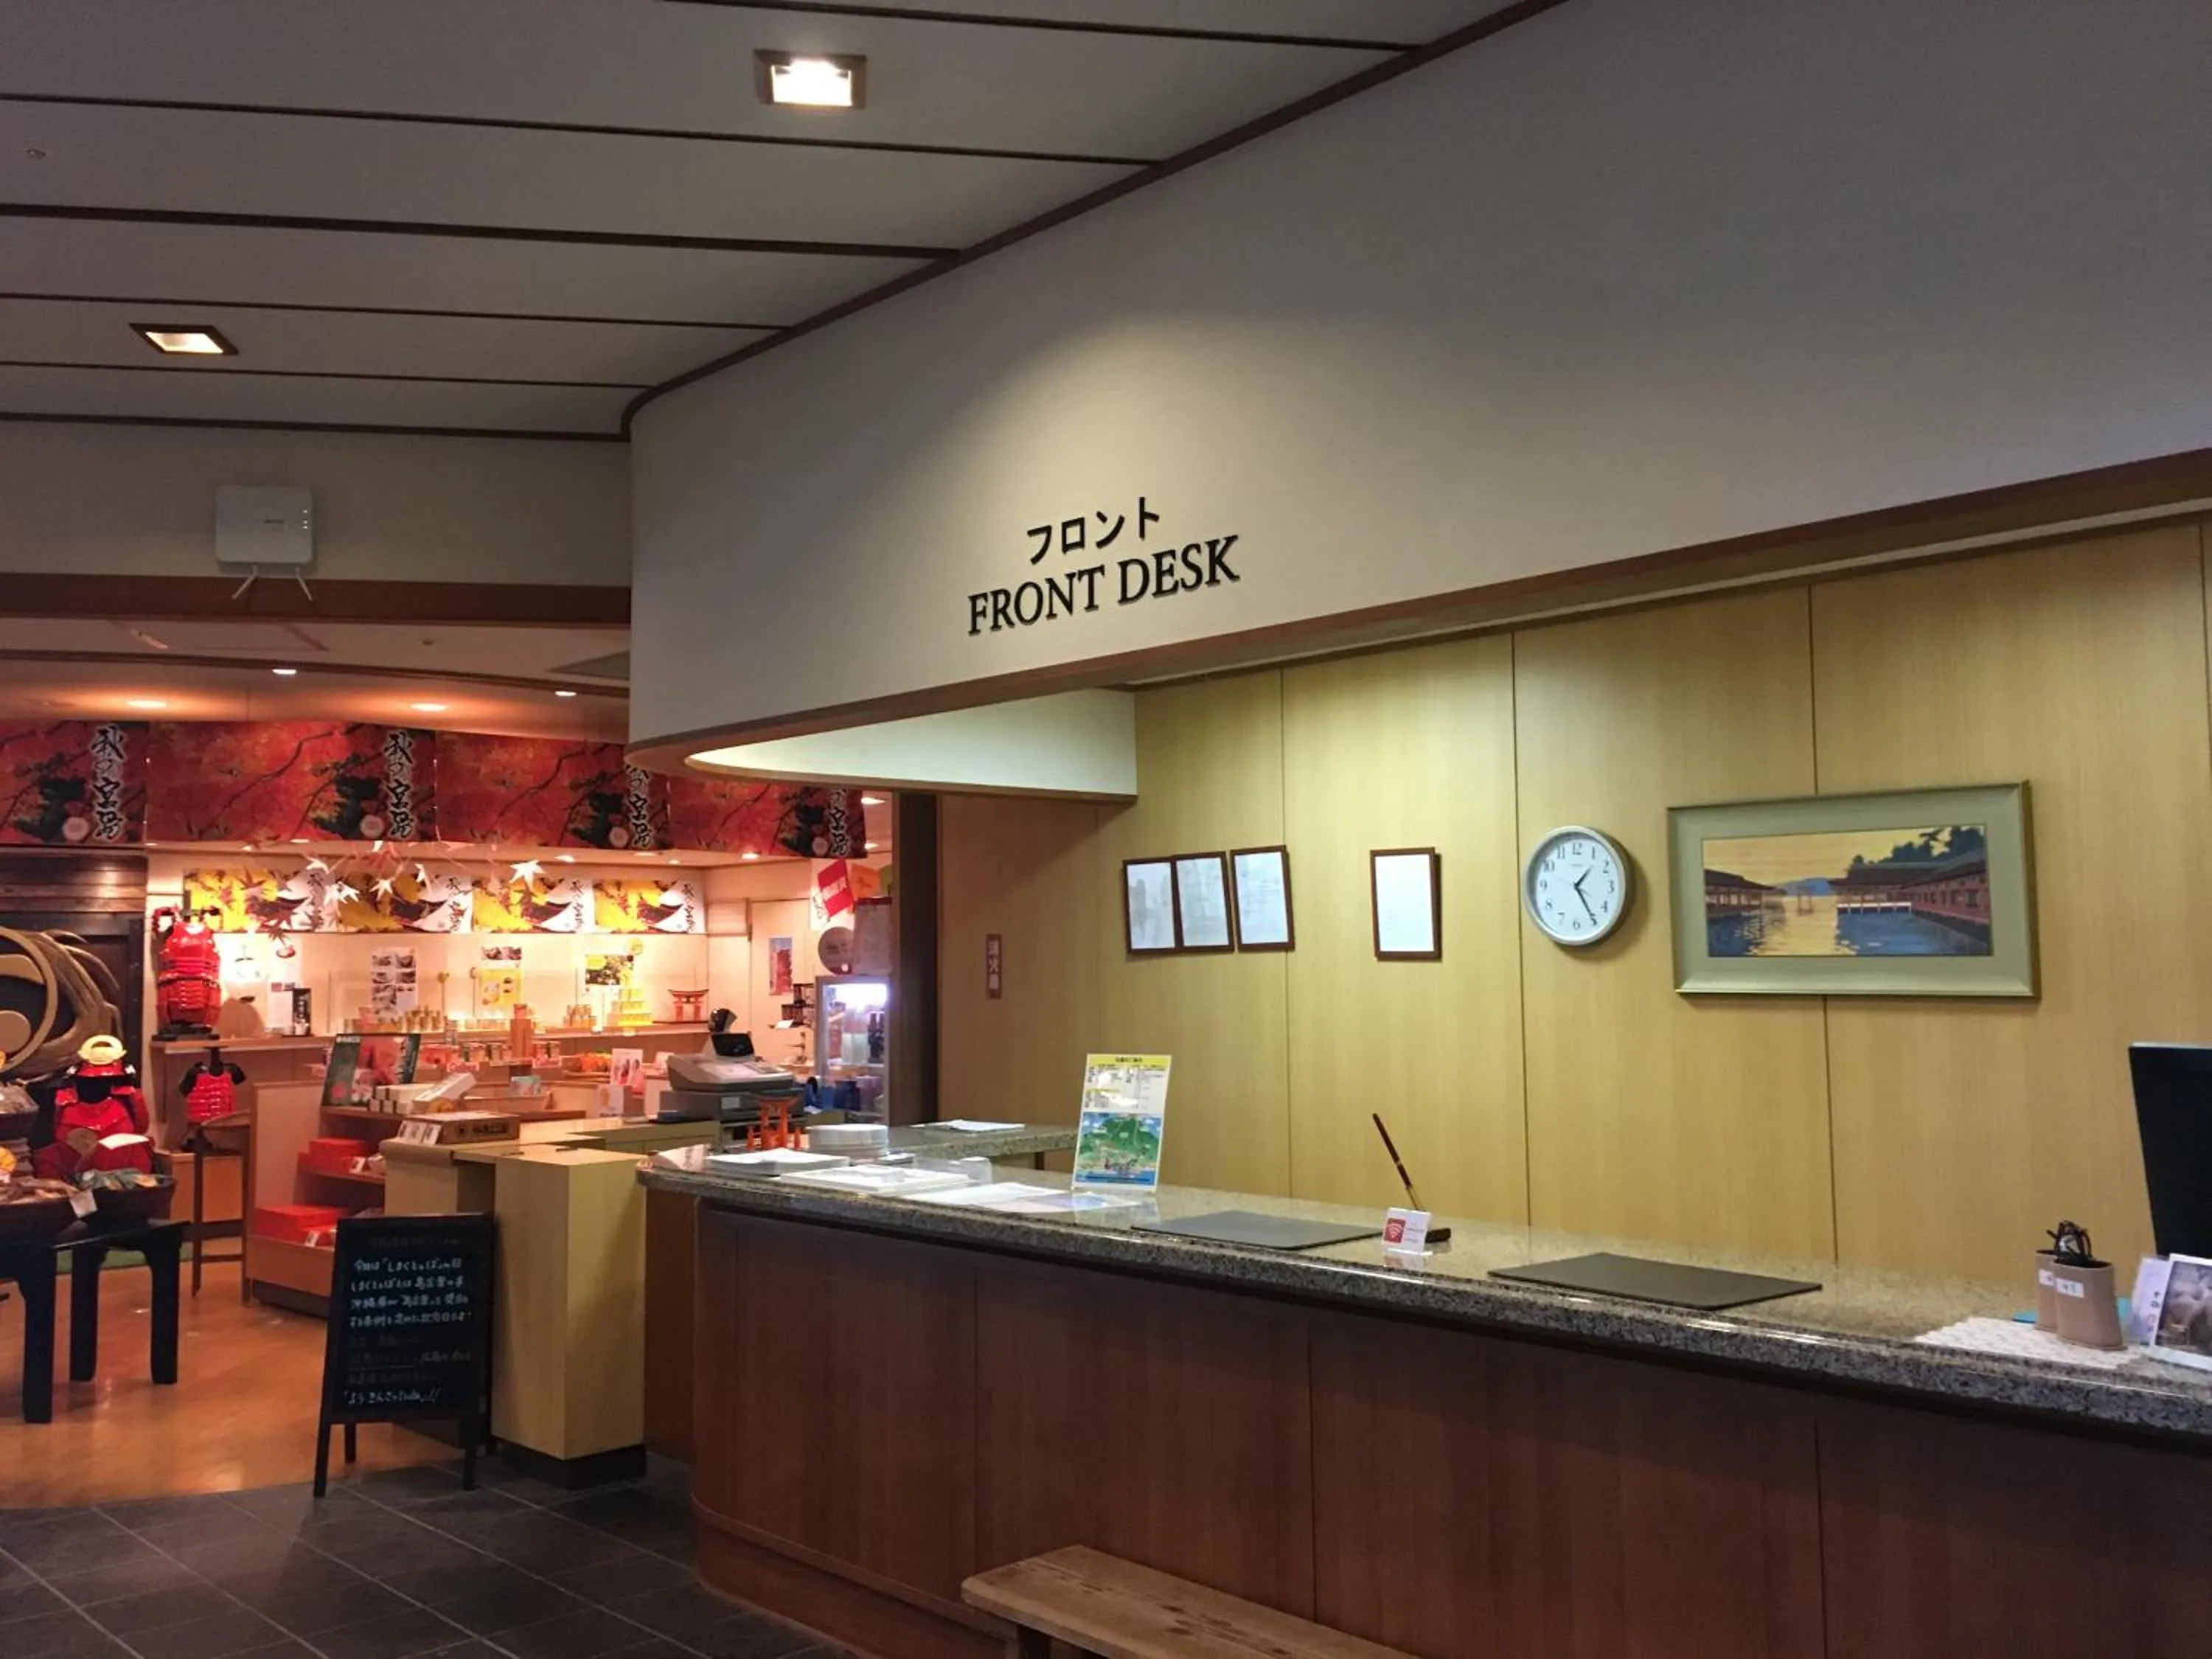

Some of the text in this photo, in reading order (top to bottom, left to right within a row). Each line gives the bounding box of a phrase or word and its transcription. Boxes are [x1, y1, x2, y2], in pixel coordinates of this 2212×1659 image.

[1026, 495, 1161, 566] フロント
[967, 534, 1241, 636] FRONT DESK
[91, 725, 125, 841] 秋の宮島
[383, 731, 415, 839] 秋の宮島
[1572, 842, 1582, 856] 12
[1602, 860, 1610, 874] 2
[1540, 879, 1548, 892] 9
[1608, 880, 1615, 894] 3
[1545, 897, 1554, 911] 8
[1600, 900, 1609, 914] 4
[1557, 911, 1565, 926] 7
[1573, 920, 1581, 931] 6
